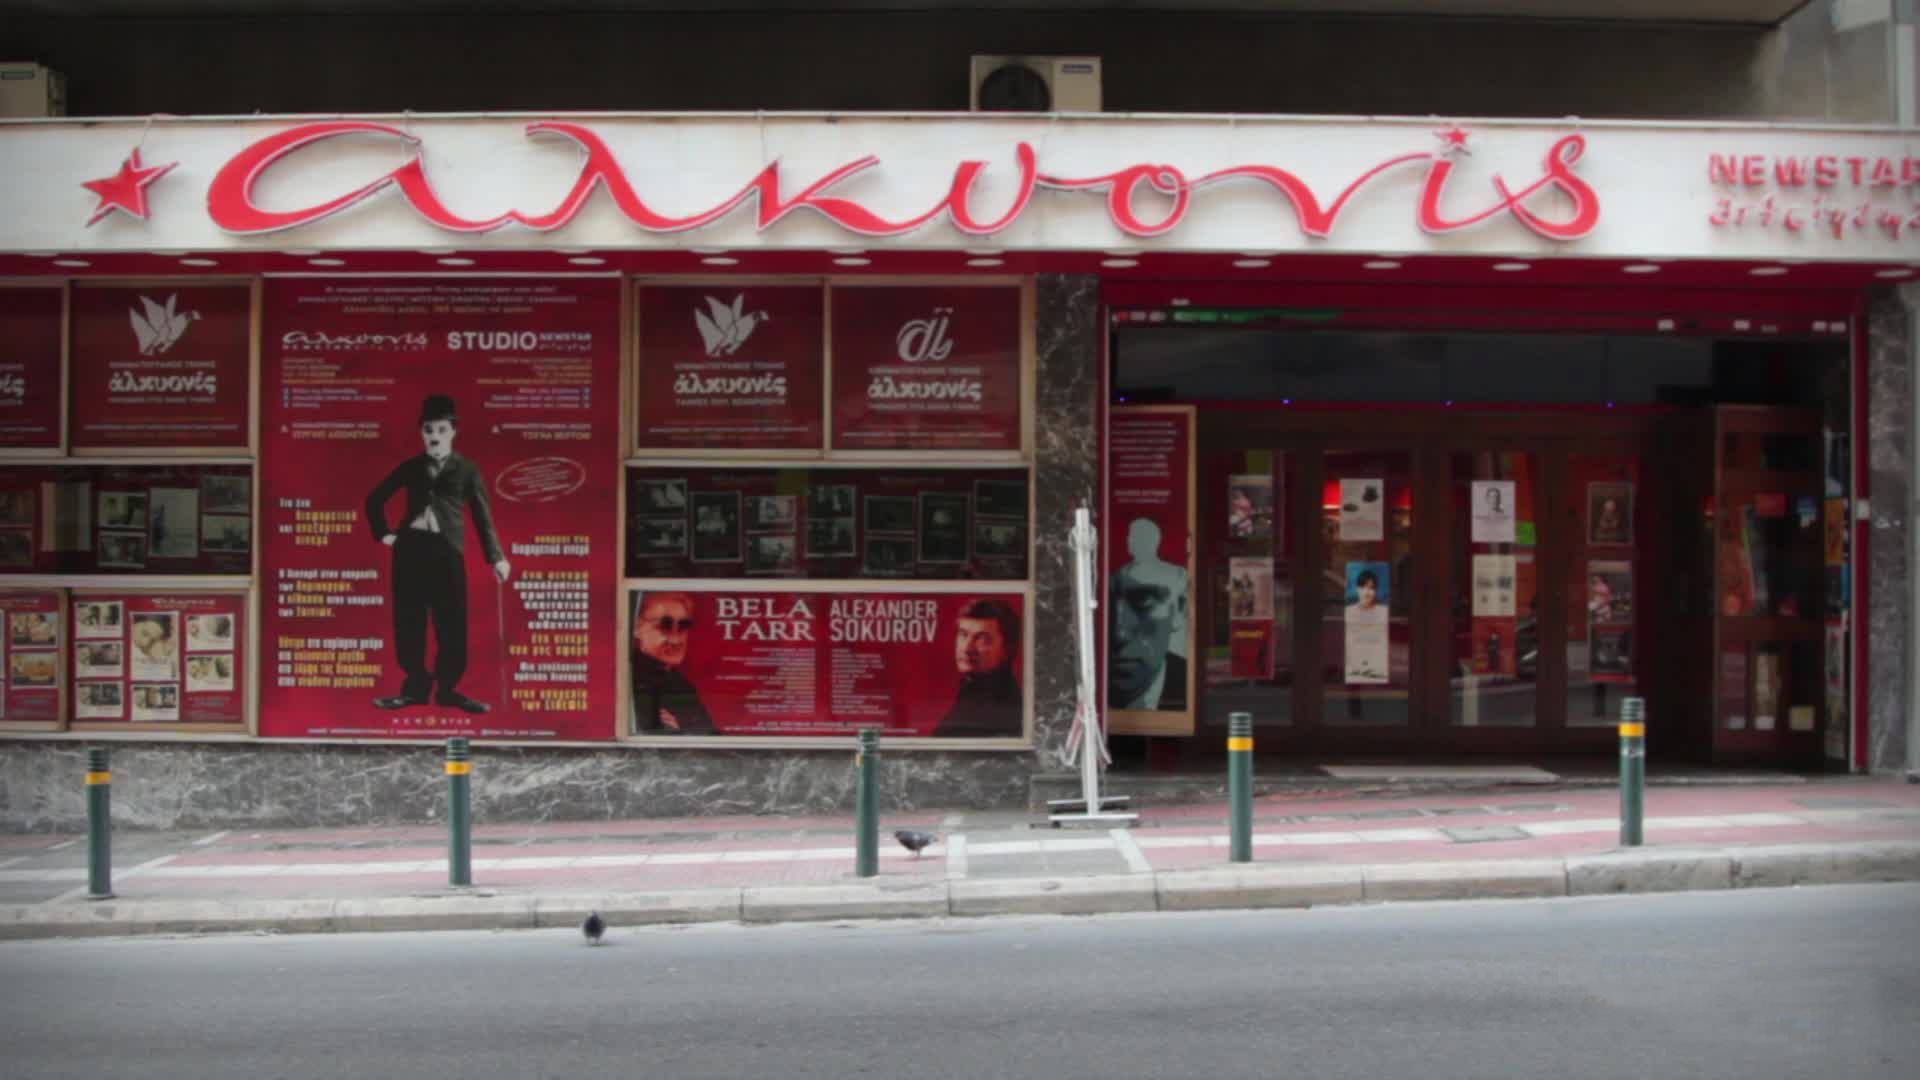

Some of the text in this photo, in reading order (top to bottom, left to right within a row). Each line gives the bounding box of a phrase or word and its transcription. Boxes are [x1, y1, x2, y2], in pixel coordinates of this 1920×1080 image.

[447, 331, 537, 351] STUDIO
[716, 598, 815, 619] BELA
[830, 599, 938, 619] ALEXANDER
[716, 620, 816, 641] TARR
[830, 620, 938, 642] SOKUROV
